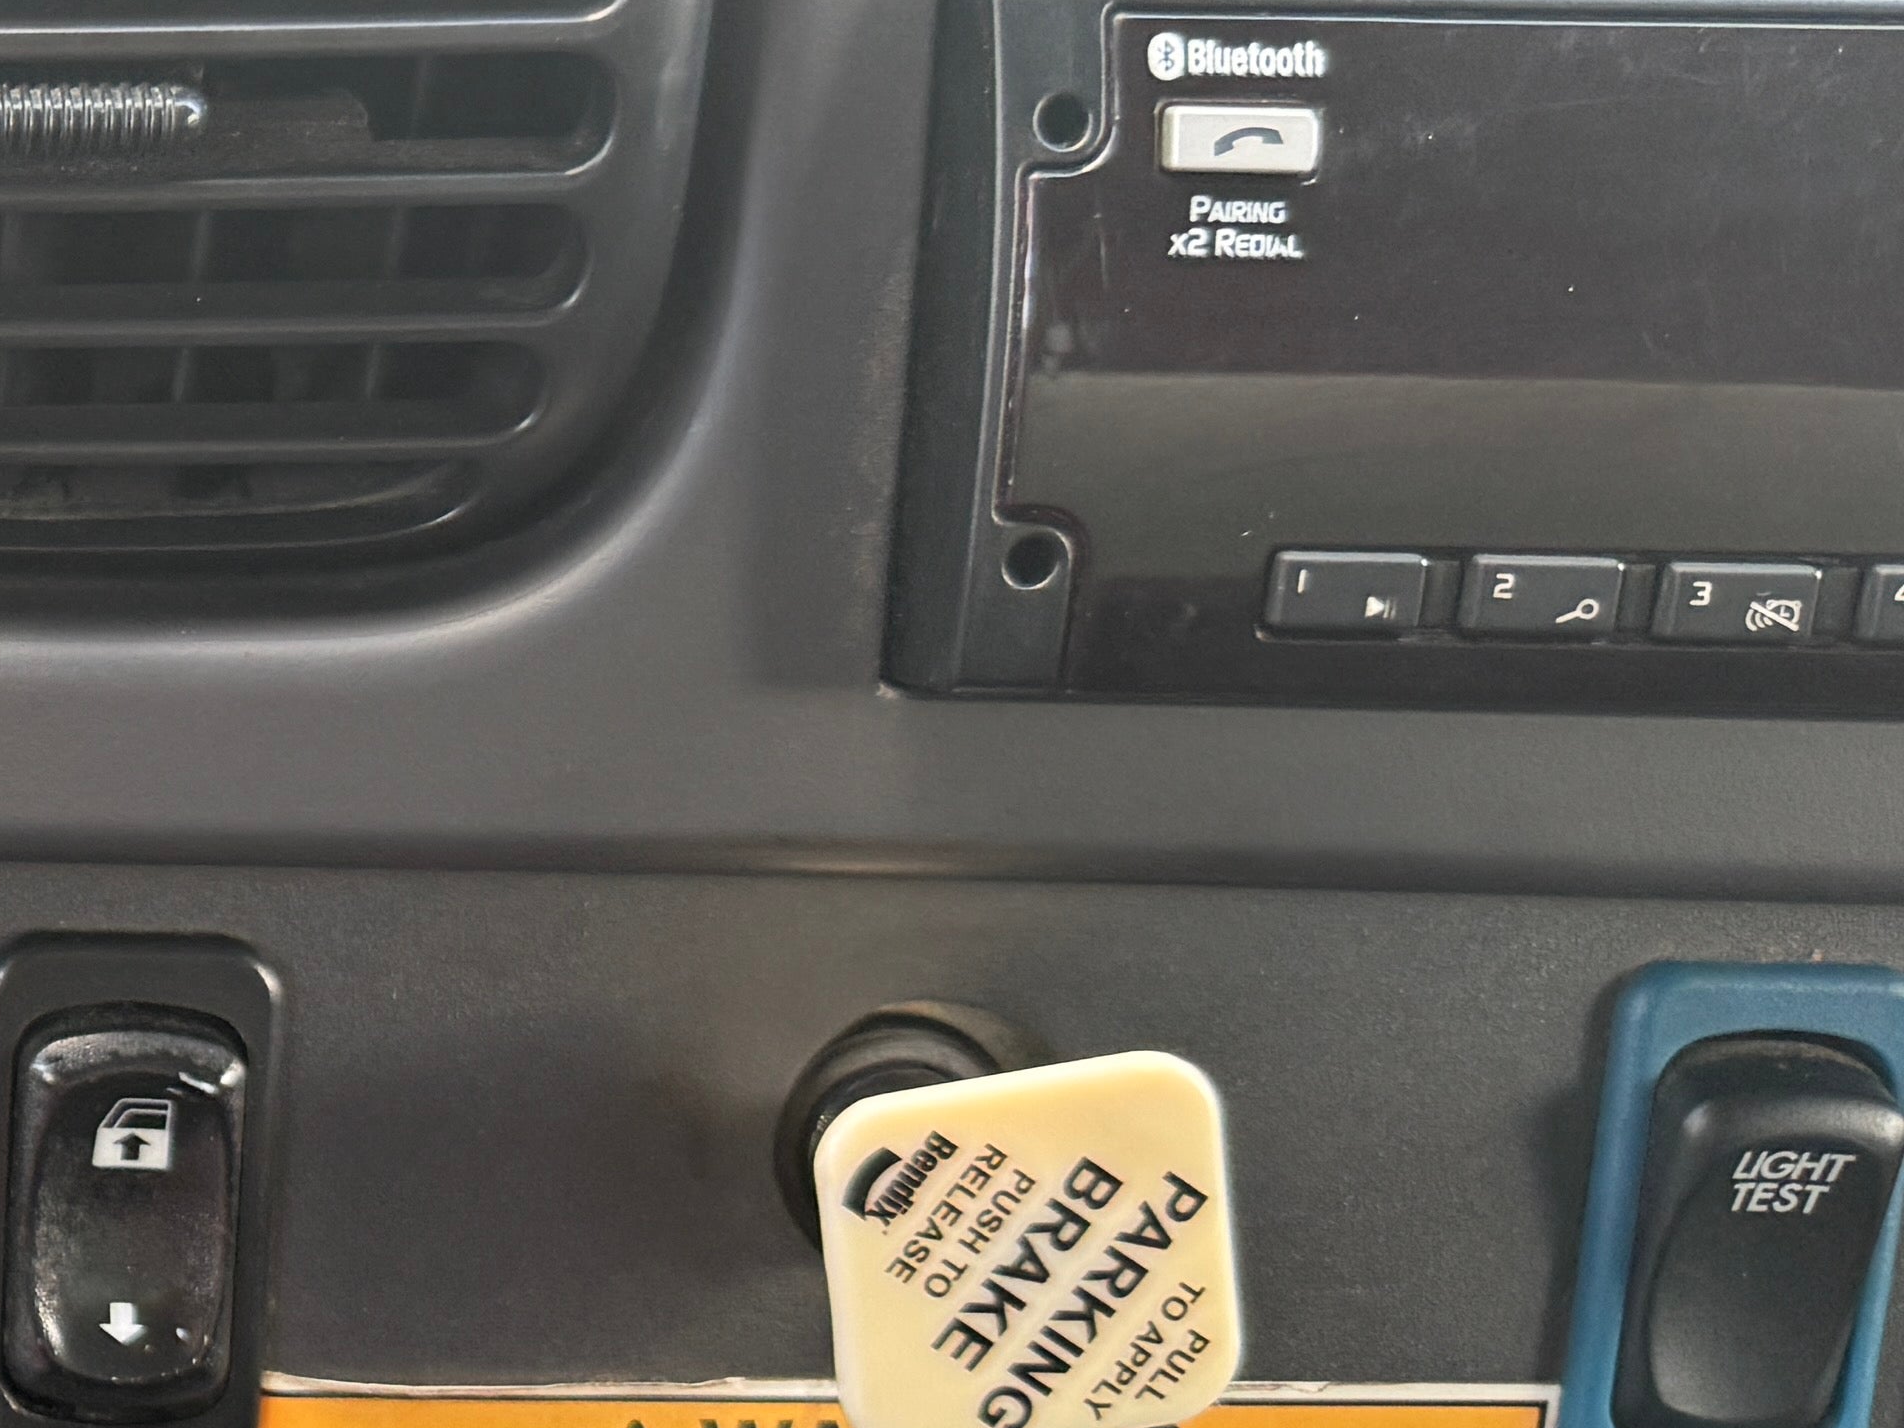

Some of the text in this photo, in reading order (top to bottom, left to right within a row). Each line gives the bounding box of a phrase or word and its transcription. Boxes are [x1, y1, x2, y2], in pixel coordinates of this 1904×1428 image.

[1187, 39, 1327, 78] Bluetooth
[1492, 573, 1517, 599] 2
[1689, 581, 1713, 606] 3
[864, 1130, 959, 1227] Bendix
[1731, 1182, 1831, 1214] TEST
[1732, 1149, 1856, 1183] LIGHT
[884, 1143, 1008, 1283] RELEASE
[924, 1169, 1036, 1298] PUSH TO
[931, 1157, 1123, 1372] BRAKE
[1083, 1281, 1206, 1420] TO APPLY
[1136, 1329, 1211, 1400] PULL
